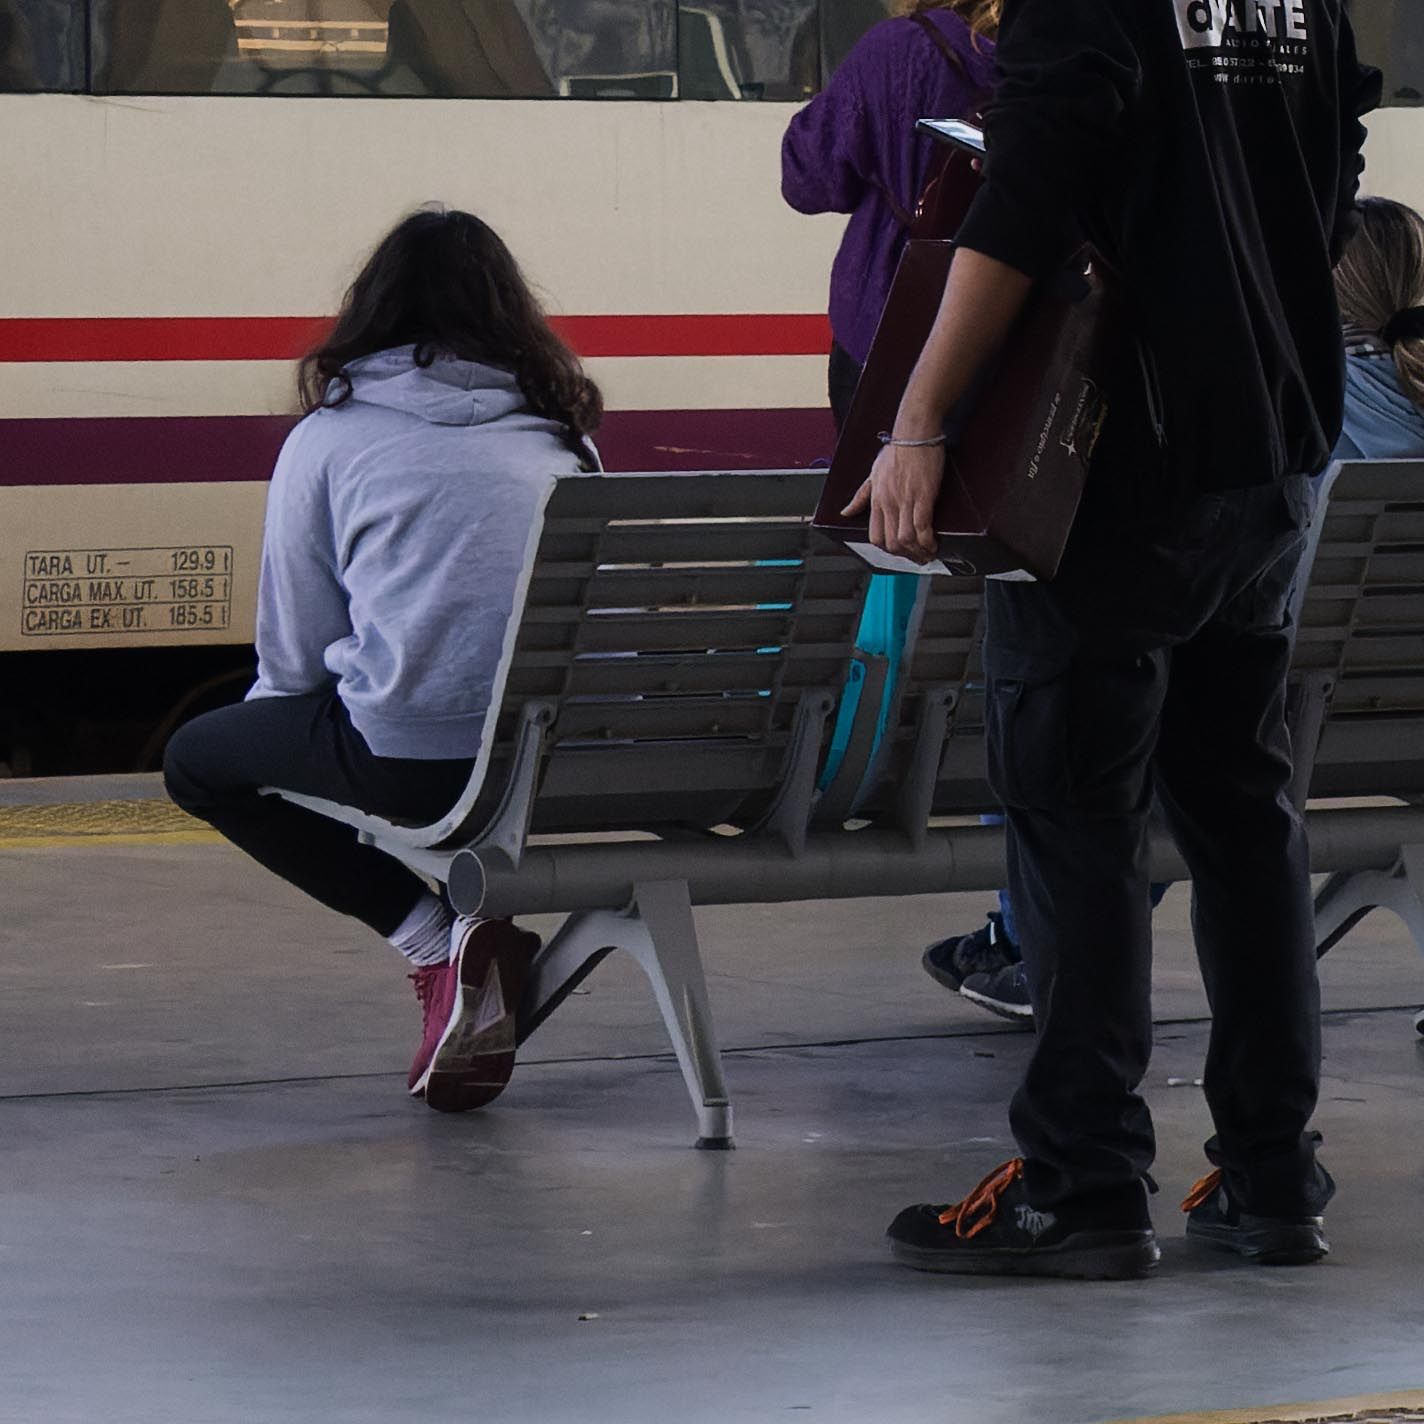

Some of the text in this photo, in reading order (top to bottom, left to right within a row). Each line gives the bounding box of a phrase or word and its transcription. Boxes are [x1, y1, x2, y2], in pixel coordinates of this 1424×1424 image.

[29, 555, 73, 576] TARA
[87, 553, 111, 574] UT.
[27, 582, 82, 604] CARGA
[134, 579, 159, 601] UT.
[26, 610, 82, 632] CARGA
